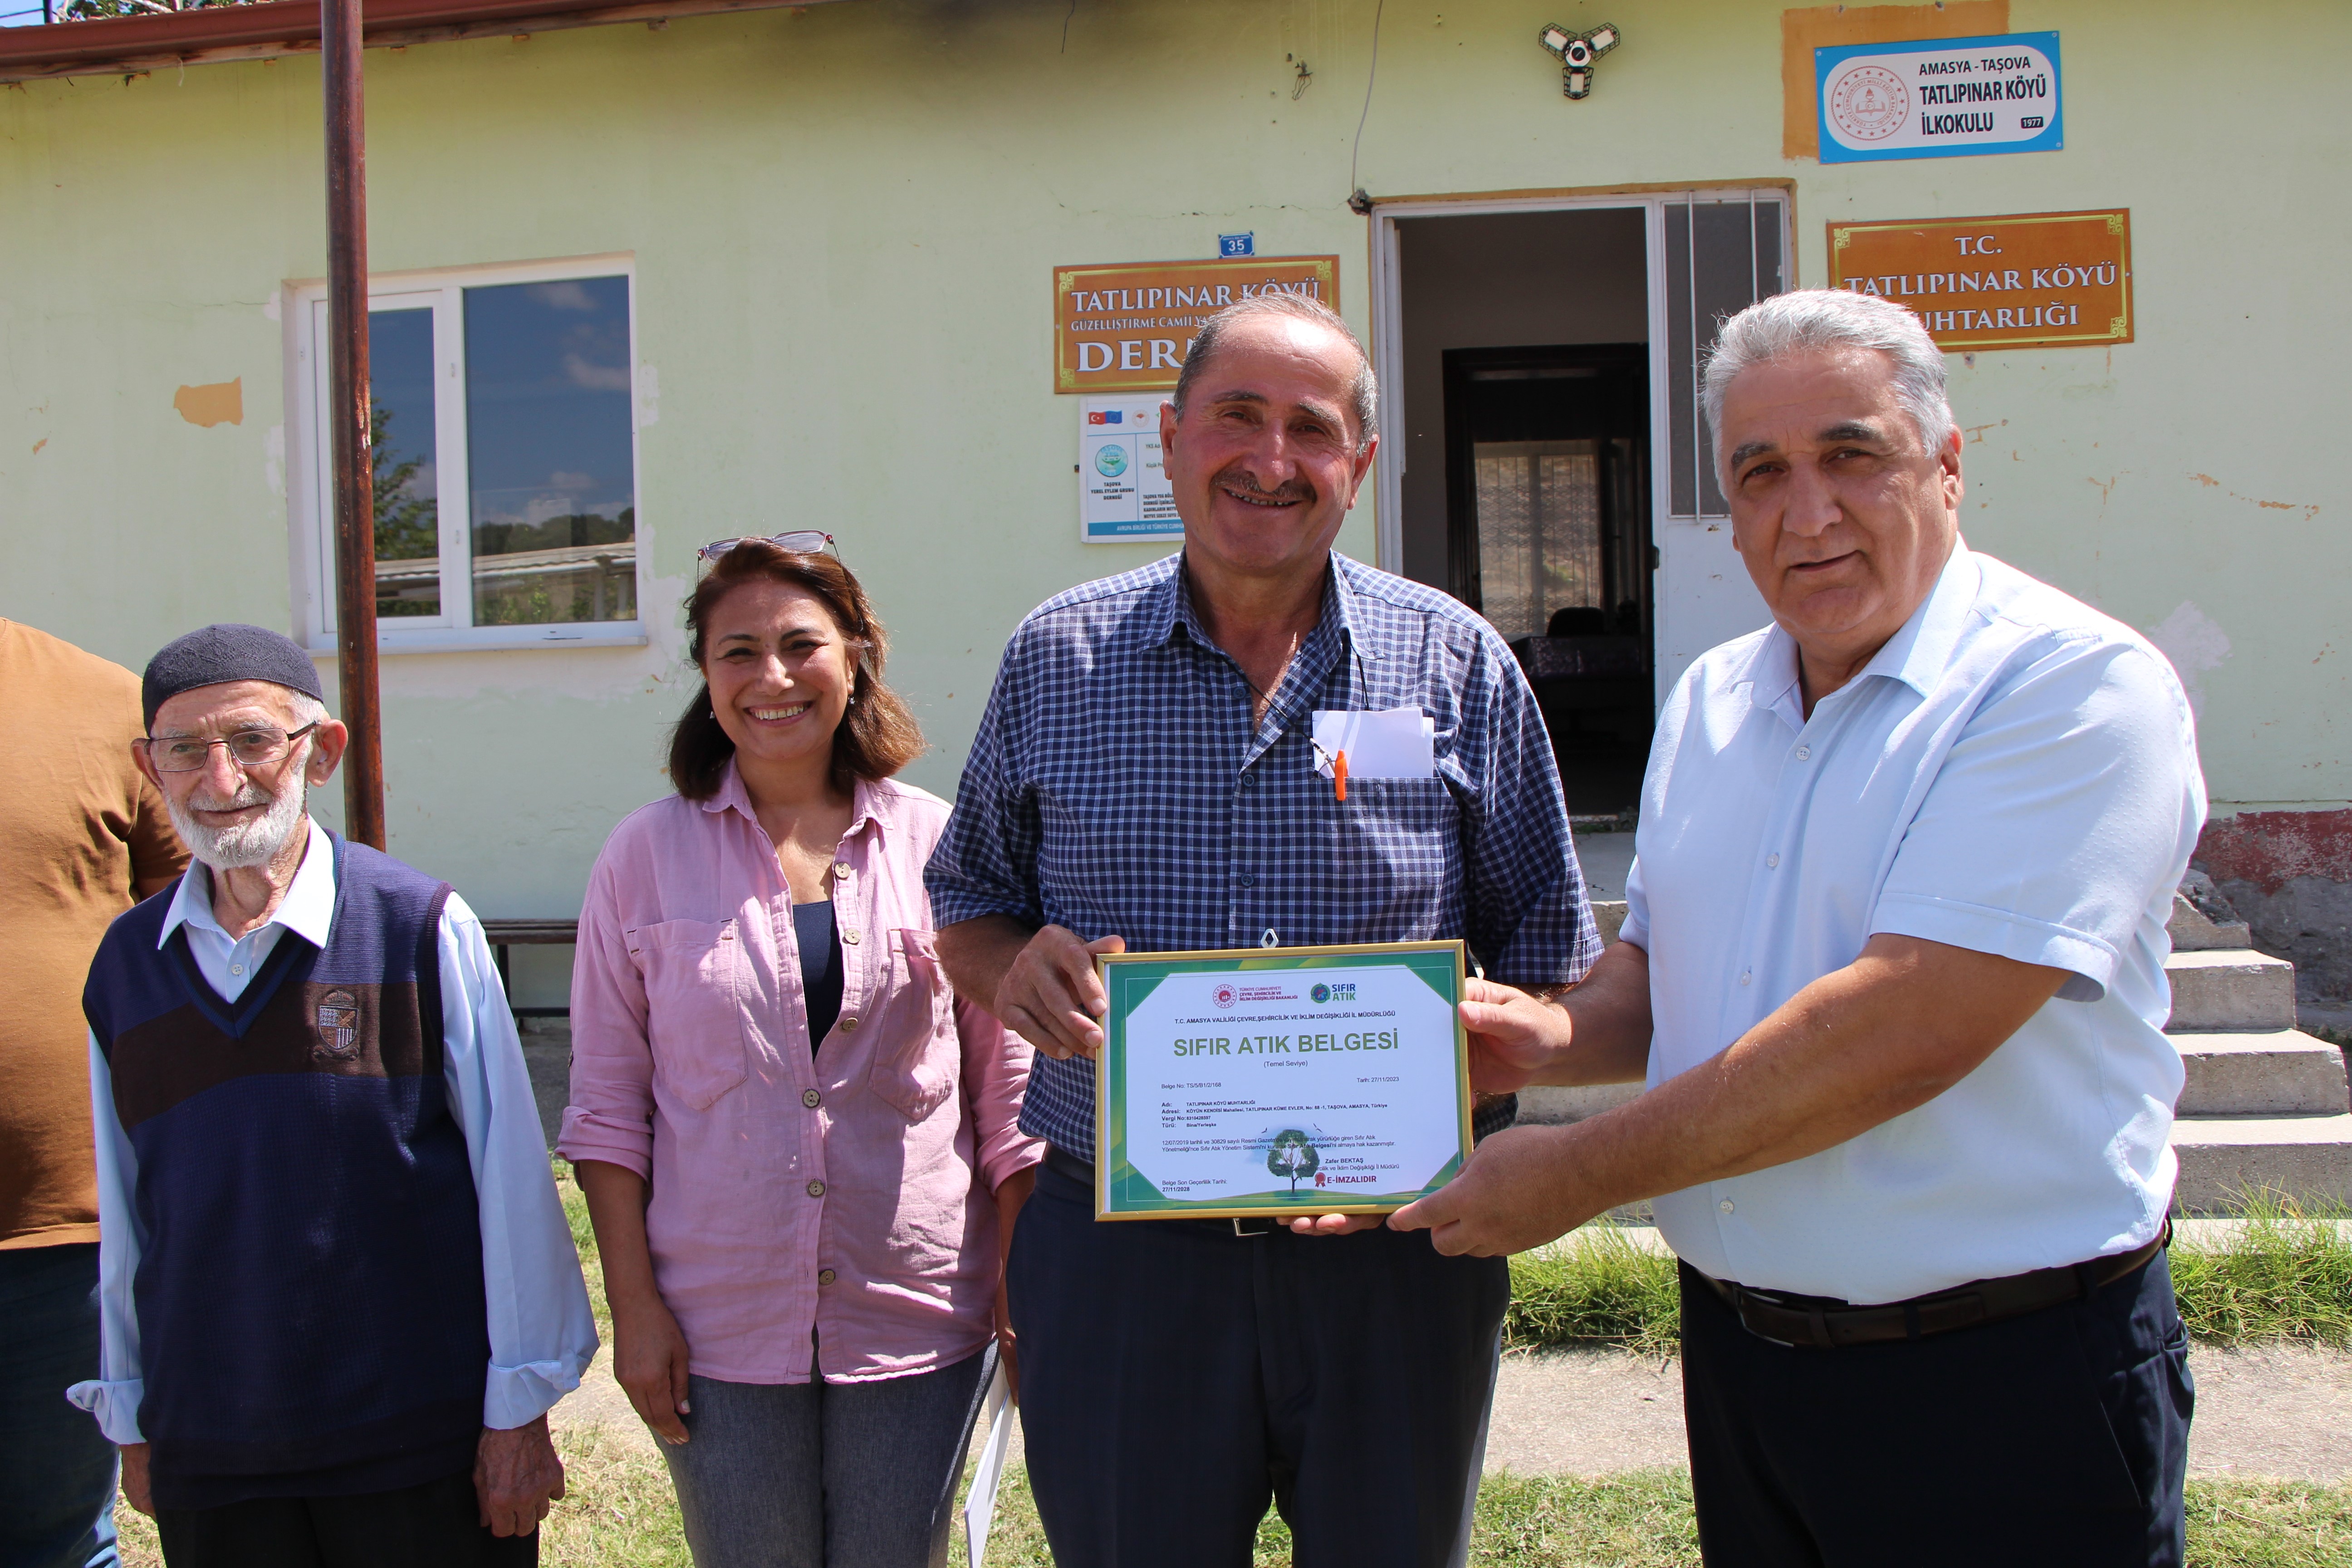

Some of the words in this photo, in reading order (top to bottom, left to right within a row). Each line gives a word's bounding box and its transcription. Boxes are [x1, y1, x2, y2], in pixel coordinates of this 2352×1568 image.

[1920, 61, 1971, 75] AMASYA
[1981, 57, 2031, 74] TAŞOVA
[1883, 84, 1896, 101] EĞİTİM
[1920, 81, 2004, 105] TATLIPINAR
[2005, 74, 2047, 100] KÖYÜ
[1922, 113, 1993, 135] İLKOKULU
[2023, 118, 2042, 128] 1977
[1228, 239, 1245, 251] 35
[1955, 235, 2003, 256] T.C.
[1844, 269, 2027, 296] TATLIPINAR
[2032, 261, 2117, 289] KÖYÜ
[1071, 284, 1232, 312] TATLIPINAR
[1071, 316, 1156, 332] GÜZELLİŞTİRME
[1158, 314, 1193, 328] CAMİİ
[1912, 299, 2079, 332] UHTARLIĞI
[1332, 984, 1356, 992] SIFIR
[1333, 992, 1356, 1001] ATIK
[1174, 1037, 1231, 1056] SIFIR
[1237, 1035, 1291, 1054] ATIK
[1298, 1028, 1398, 1052] BELGESİ
[1286, 1060, 1308, 1068] Seviye)
[1327, 1174, 1377, 1184] E-İMZALIDIR
